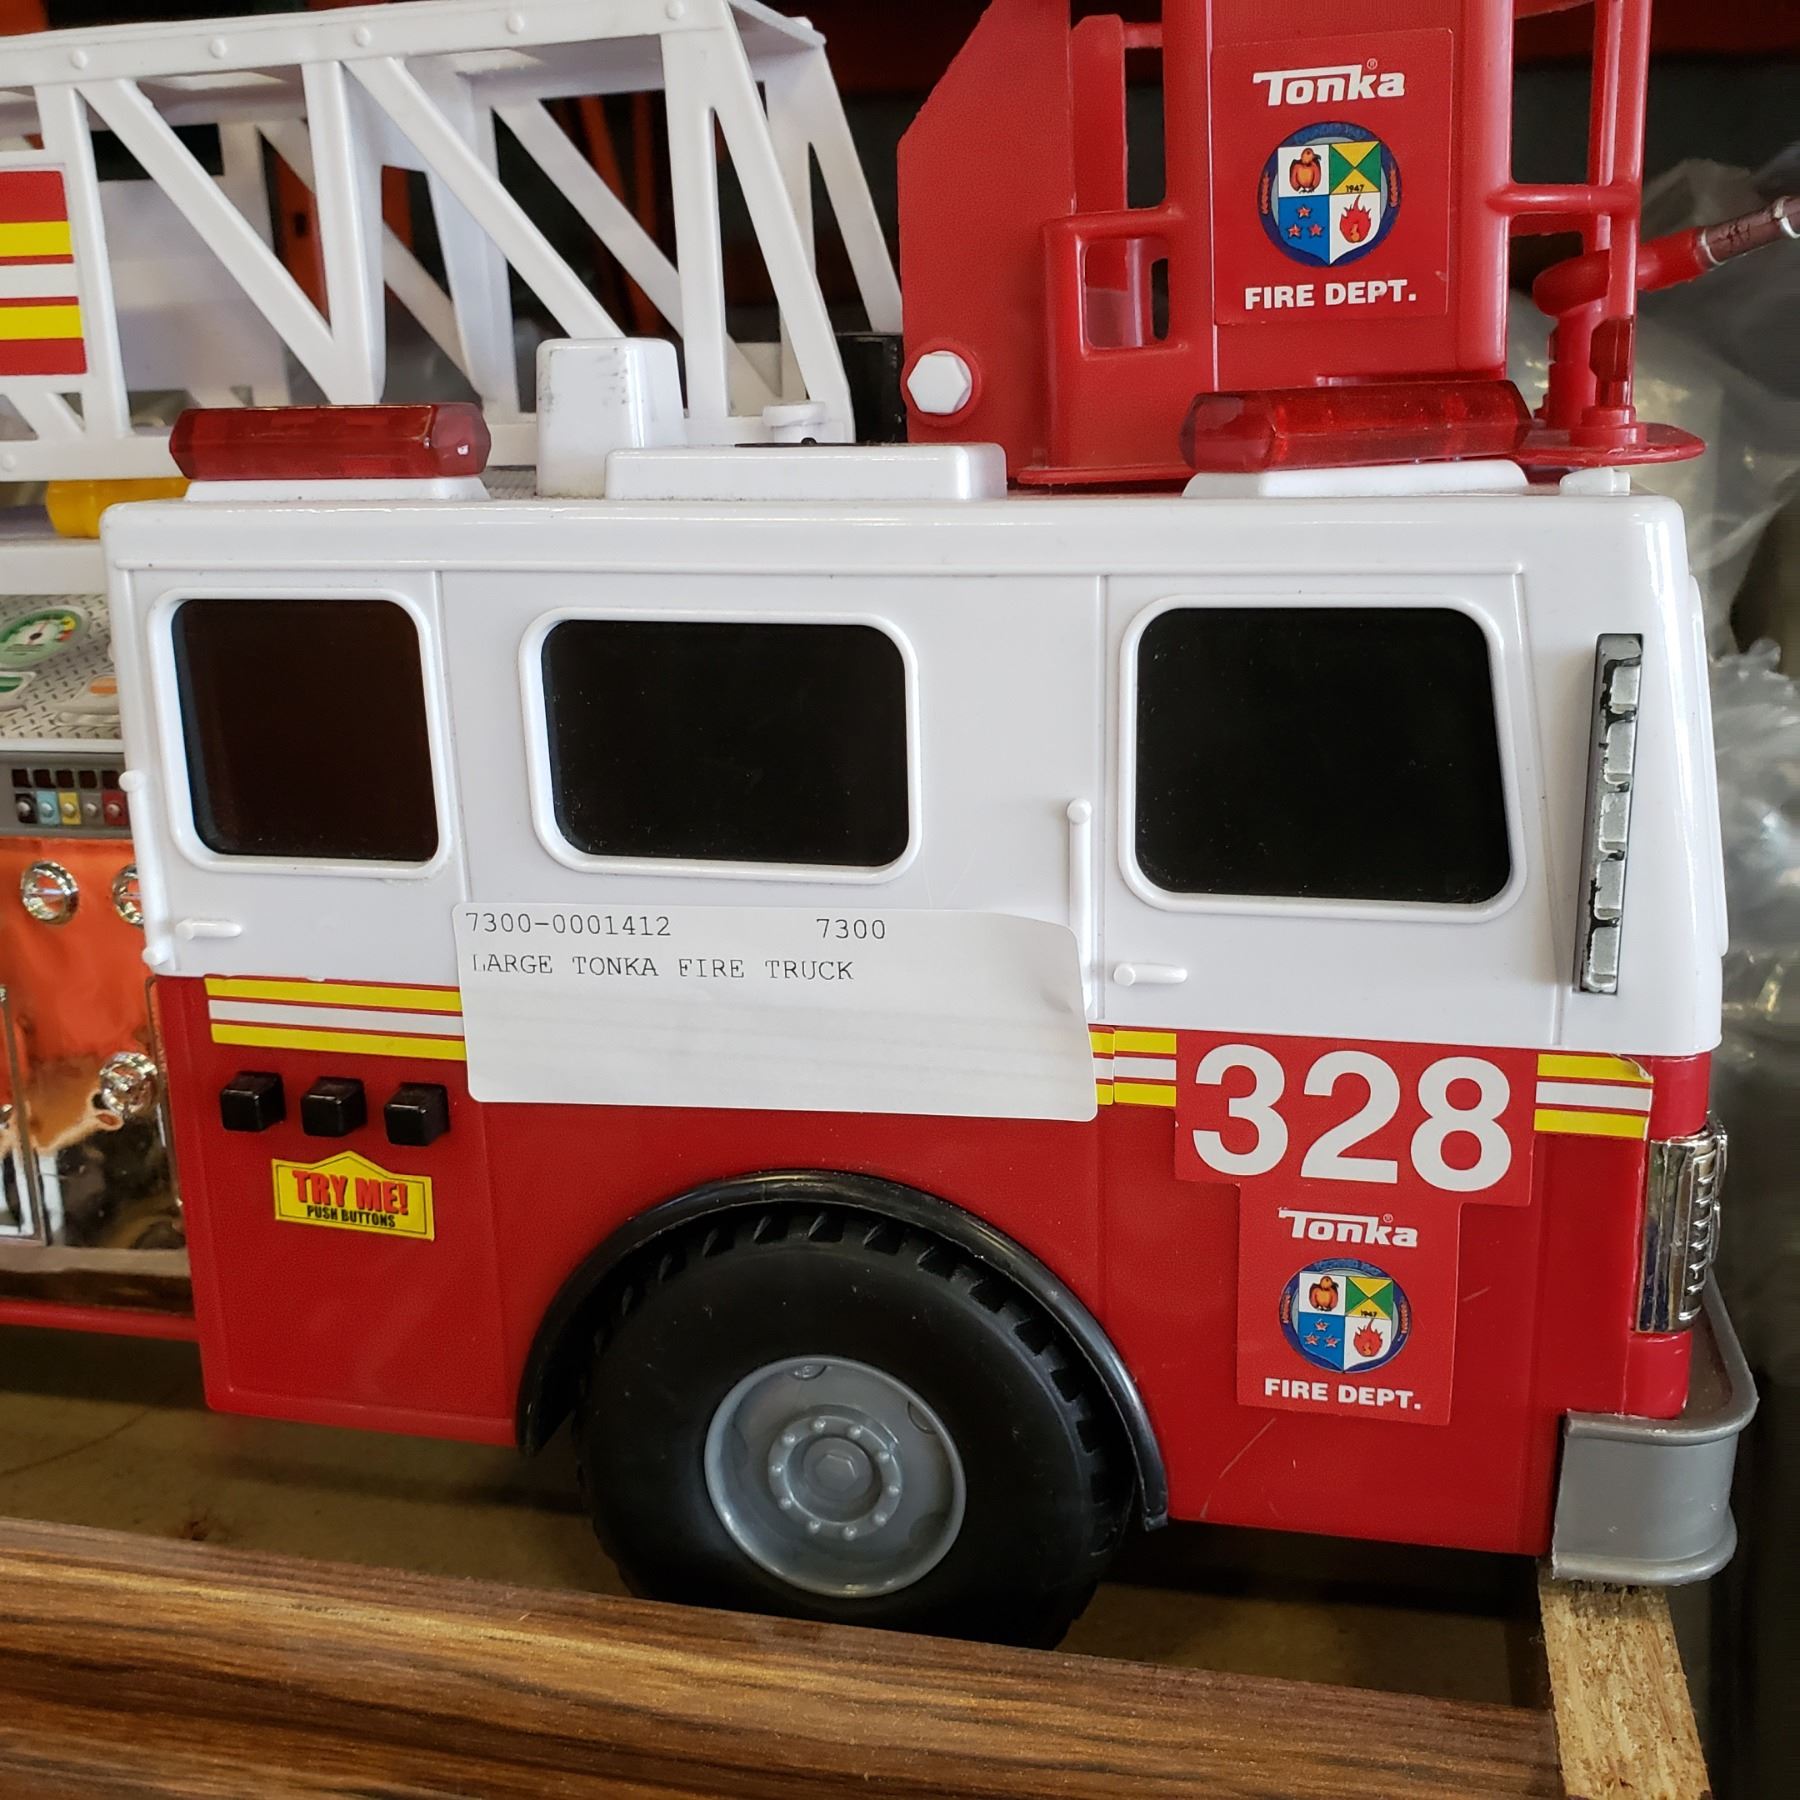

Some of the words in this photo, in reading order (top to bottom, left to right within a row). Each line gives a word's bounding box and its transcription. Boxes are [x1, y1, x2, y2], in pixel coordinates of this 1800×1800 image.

[1252, 64, 1405, 106] Tonka
[1345, 184, 1365, 193] 1947
[1244, 284, 1315, 310] FIRE
[1325, 279, 1416, 306] DEPT.
[465, 912, 671, 936] 7300-0001412
[816, 918, 886, 939] 7300
[472, 953, 553, 974] LARGE
[572, 956, 660, 977] TONKA
[678, 958, 745, 978] FIRE
[764, 960, 854, 980] TRUCK
[1192, 1043, 1512, 1192] 328
[292, 1169, 348, 1207] TRY
[354, 1176, 409, 1216] ME!
[306, 1204, 338, 1222] PUSH
[341, 1210, 396, 1228] BUTTONS
[1278, 1208, 1418, 1248] Tonka
[1264, 1377, 1328, 1401] FIRE
[1337, 1384, 1422, 1410] DEPT.
